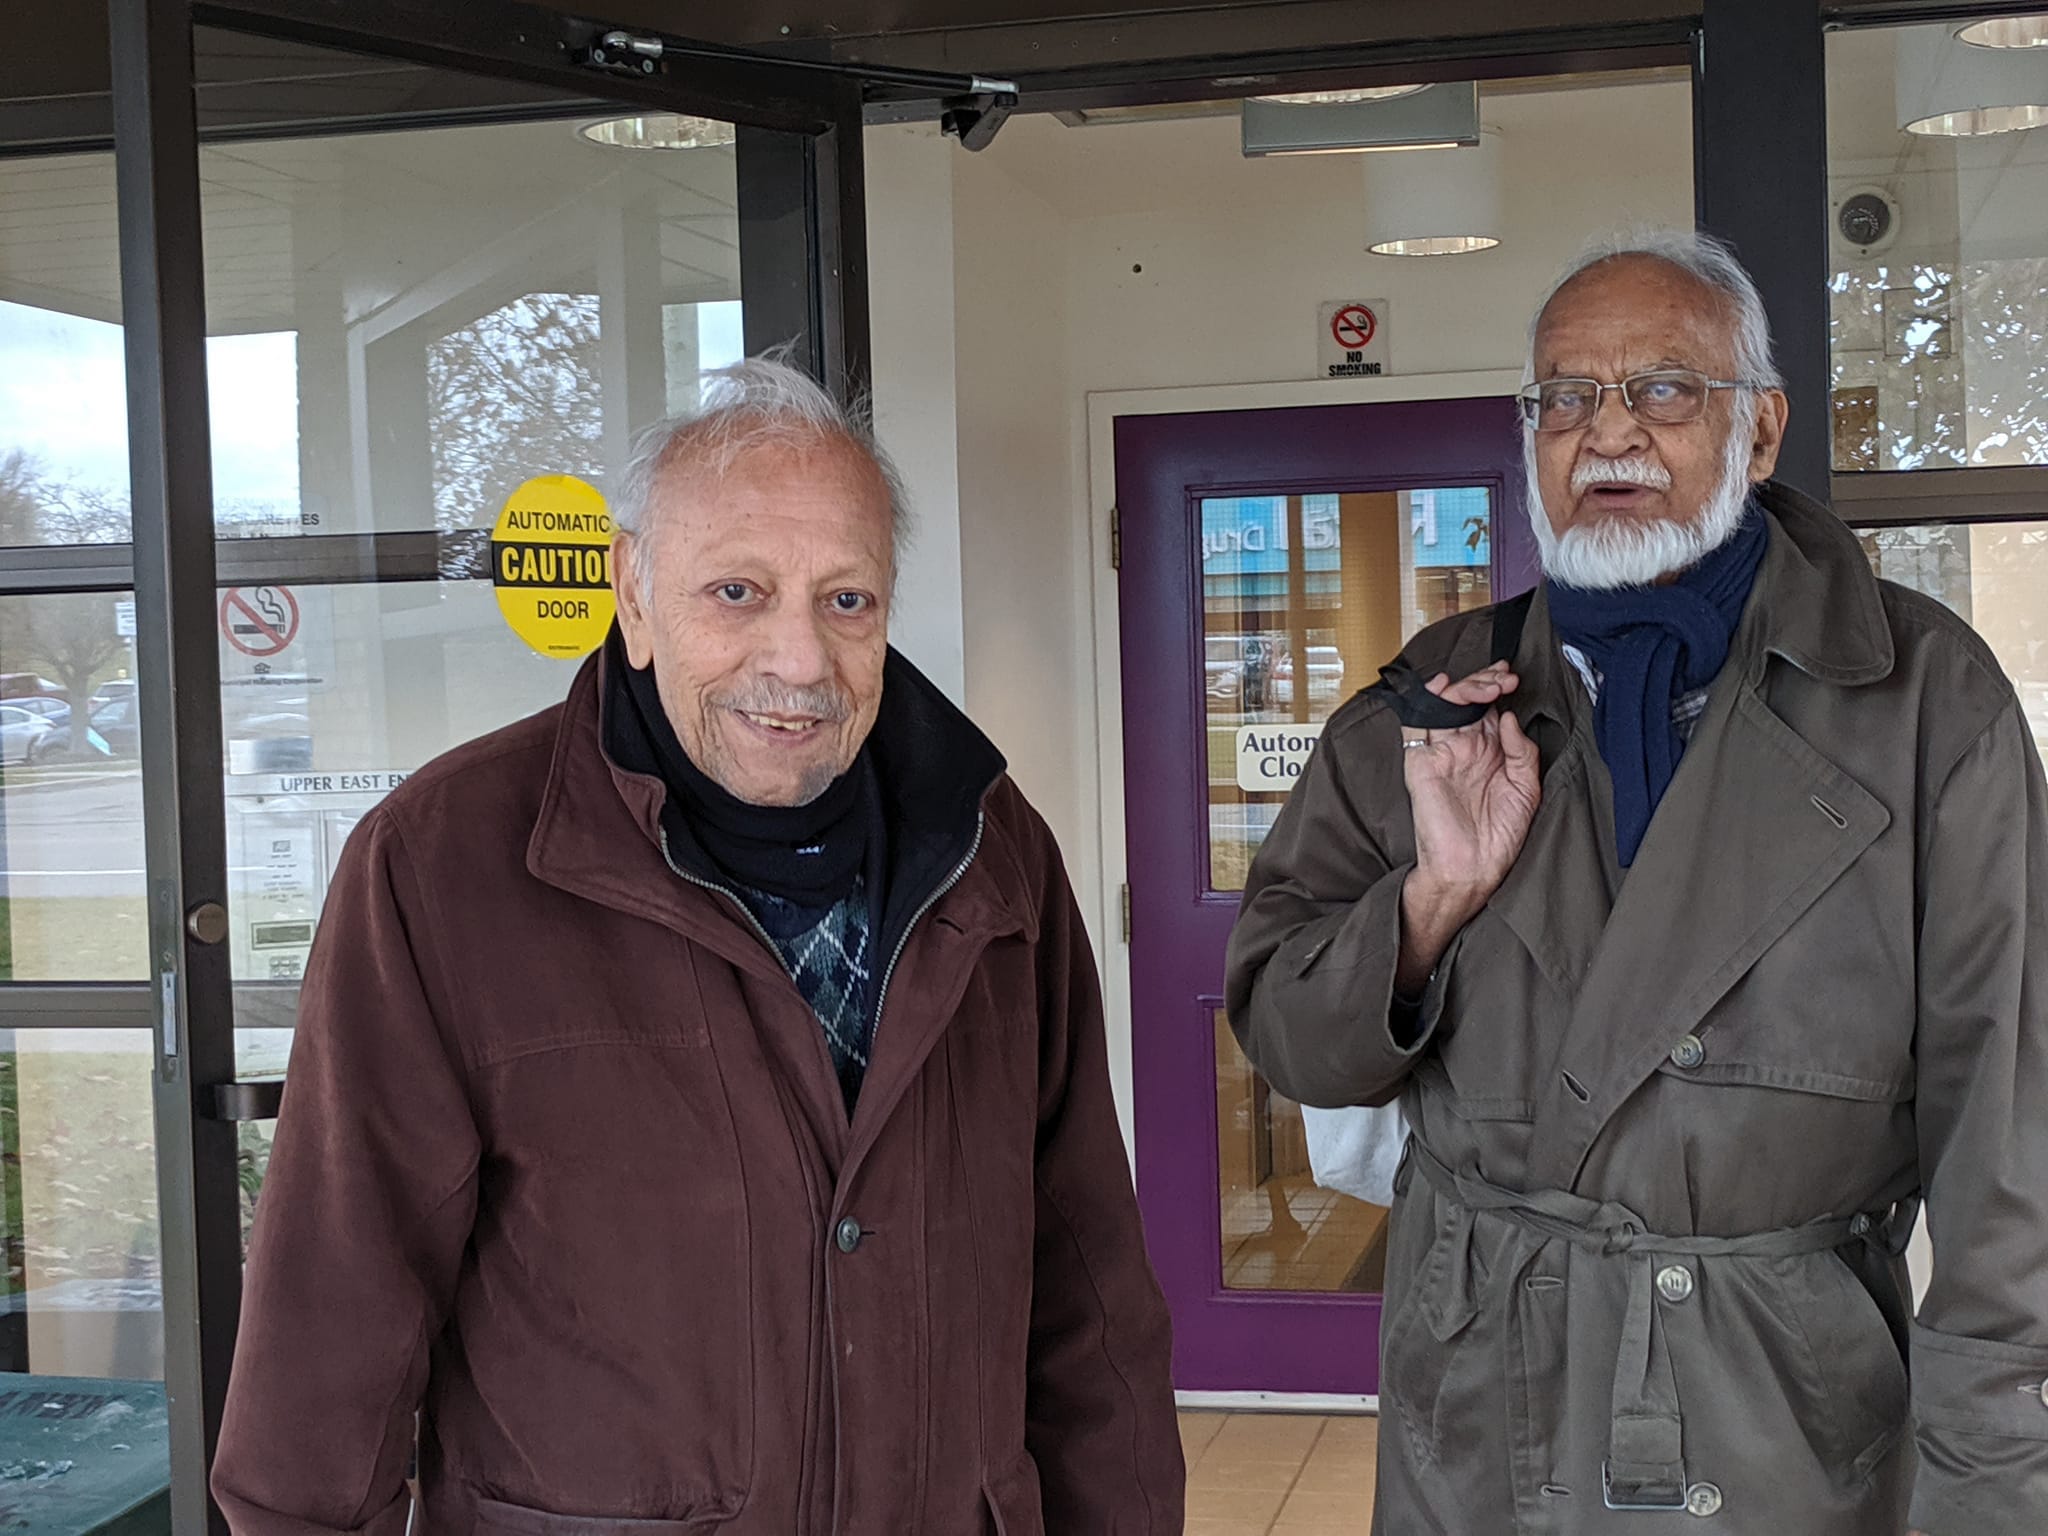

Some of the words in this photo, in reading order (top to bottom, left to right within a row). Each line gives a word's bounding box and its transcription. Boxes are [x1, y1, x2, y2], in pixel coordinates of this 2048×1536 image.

[1346, 351, 1362, 363] NO
[1328, 363, 1382, 376] SMOKING
[507, 510, 611, 533] AUTOMATIC
[537, 600, 589, 619] DOOR
[281, 777, 333, 792] UPPER
[340, 775, 382, 790] EAST
